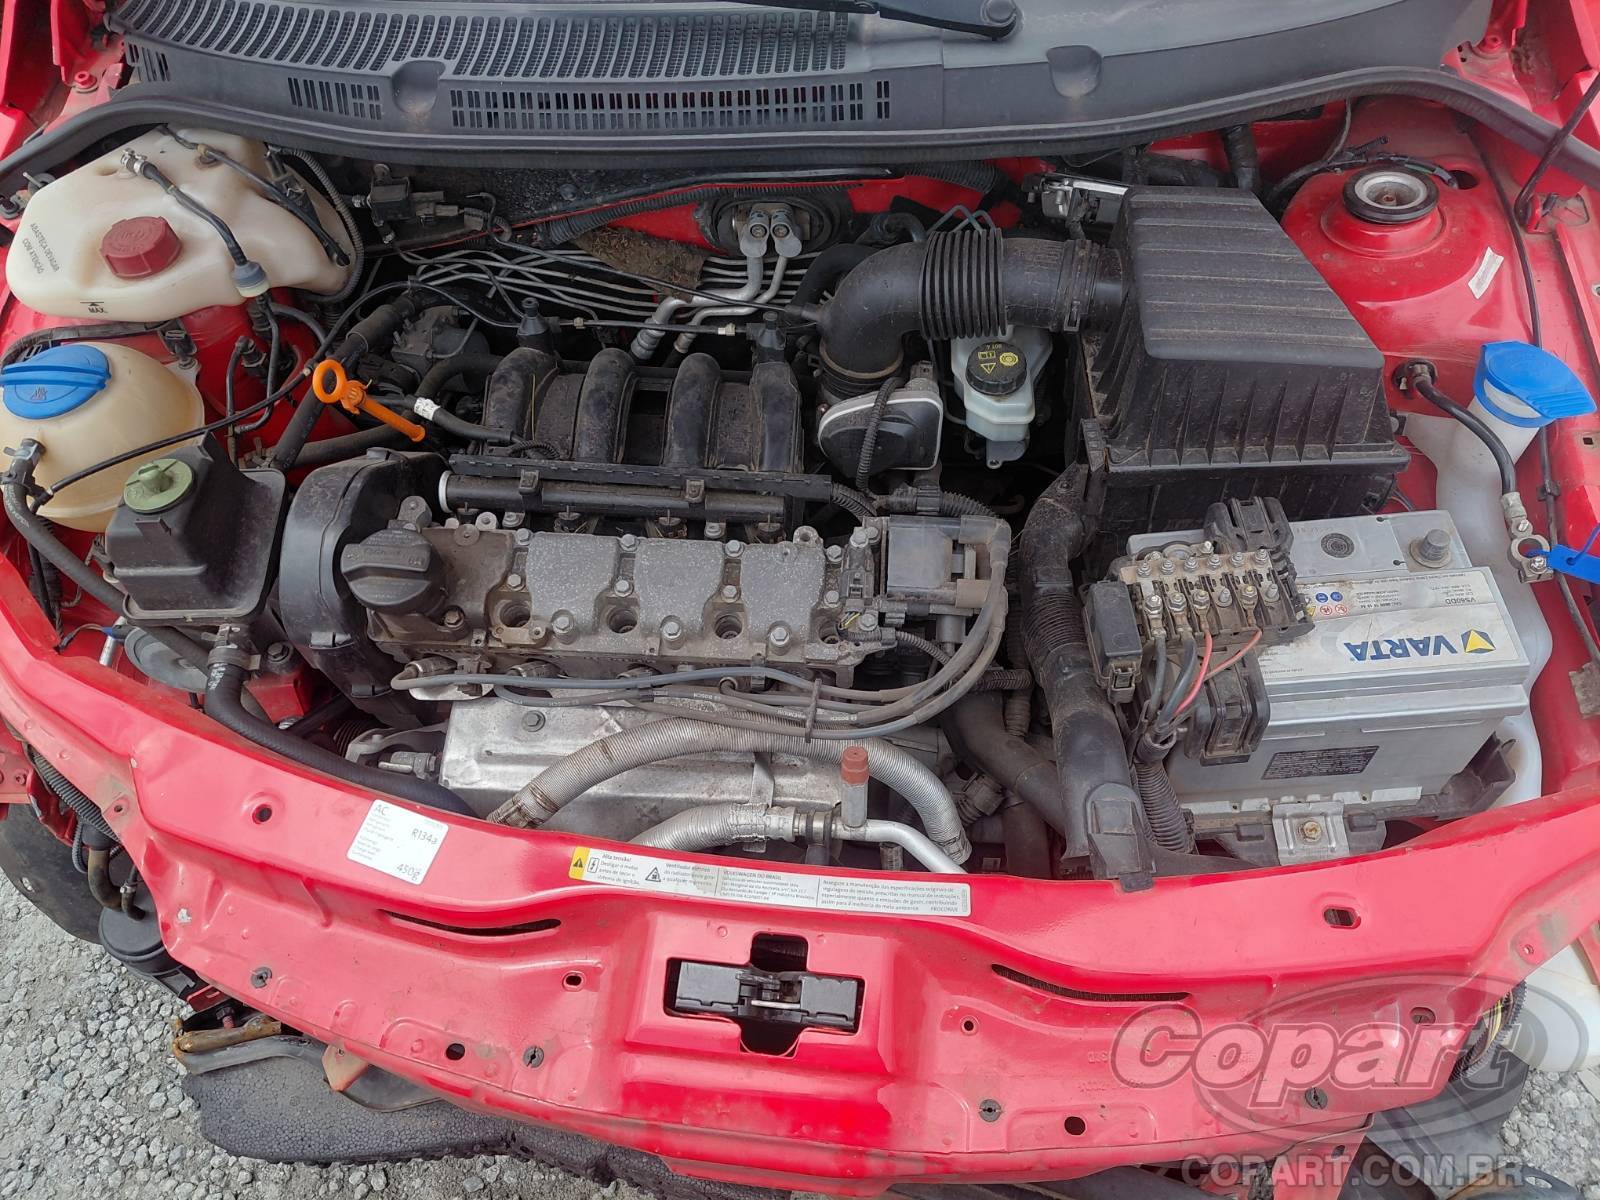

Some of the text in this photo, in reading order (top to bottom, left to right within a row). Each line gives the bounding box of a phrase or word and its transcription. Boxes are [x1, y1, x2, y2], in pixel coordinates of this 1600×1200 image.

[1344, 635, 1458, 661] VARTA
[374, 804, 390, 816] AC
[412, 827, 438, 845] R134a
[397, 863, 421, 881] 450g
